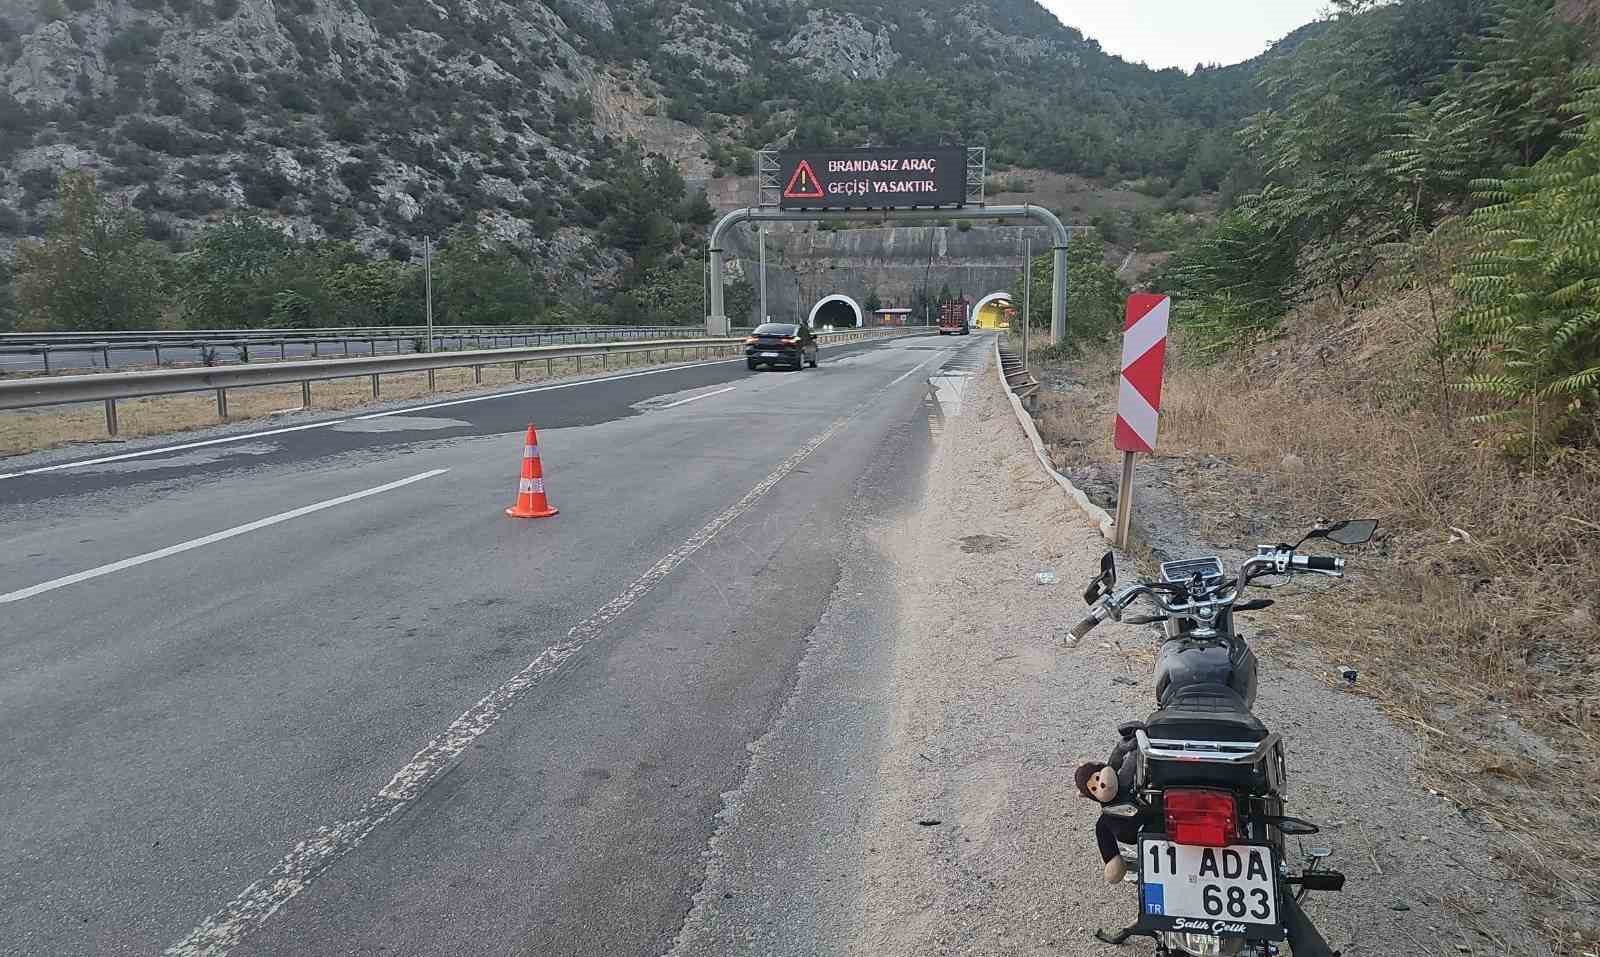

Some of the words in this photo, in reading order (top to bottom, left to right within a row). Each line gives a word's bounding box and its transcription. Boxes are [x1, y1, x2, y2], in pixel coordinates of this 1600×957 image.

[828, 159, 898, 172] BRANDASIZ
[901, 158, 936, 172] ARAÇ
[828, 178, 870, 196] GEÇİŞİ
[873, 180, 937, 192] YASAKTIR.
[1149, 844, 1177, 875] 11
[1199, 847, 1268, 881] ADA
[1147, 903, 1162, 914] TR
[1203, 884, 1270, 919] 683
[1212, 921, 1247, 935] Çelik
